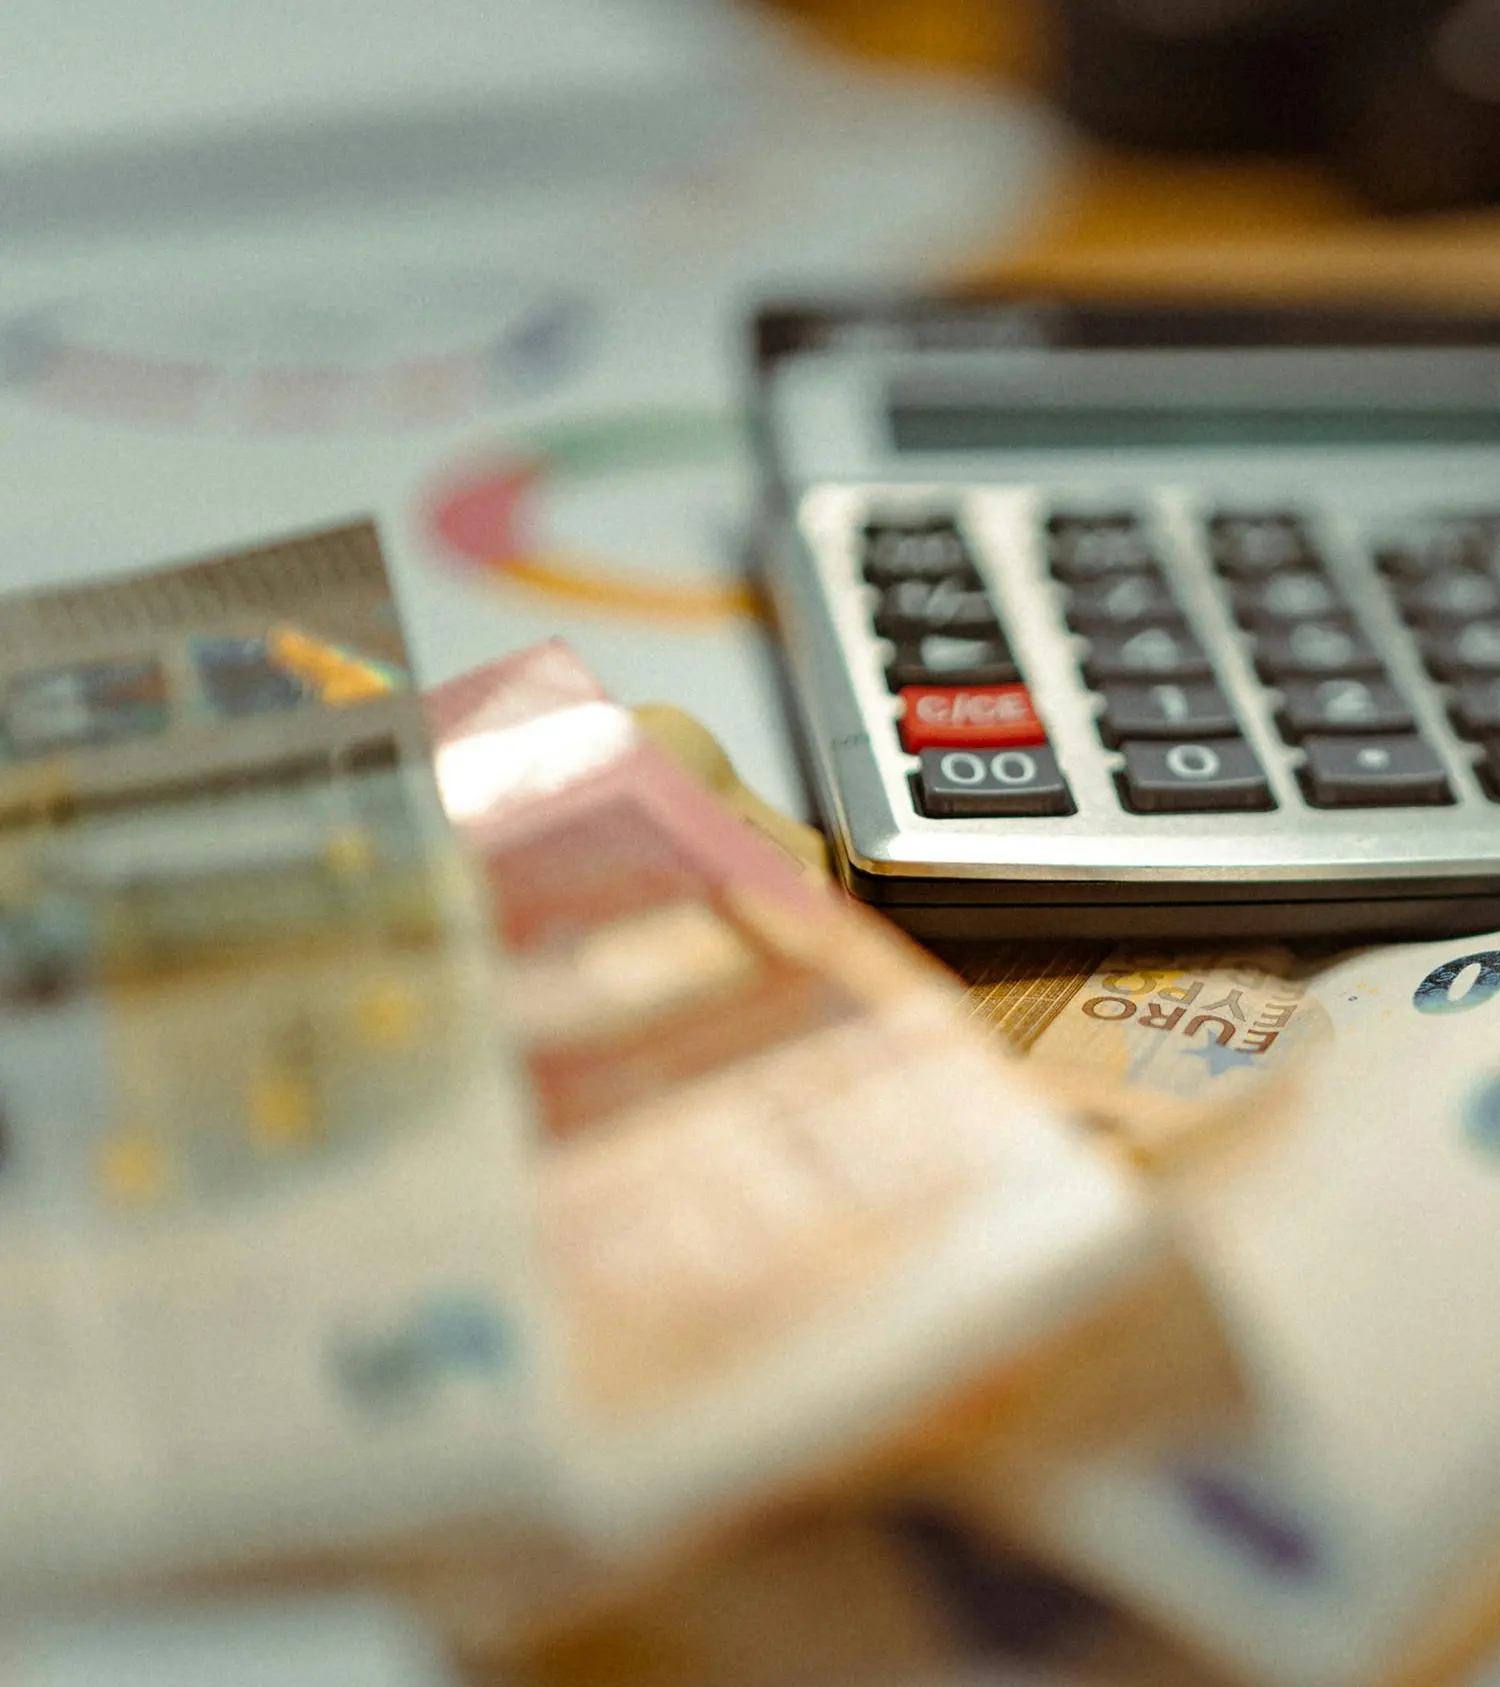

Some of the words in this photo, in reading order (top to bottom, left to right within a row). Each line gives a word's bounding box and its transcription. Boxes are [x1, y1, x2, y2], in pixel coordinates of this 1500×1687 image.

[915, 690, 1028, 727] C/CE
[1152, 683, 1189, 725] 1
[940, 751, 1038, 786] 00
[1165, 744, 1220, 779] 0
[1081, 995, 1280, 1055] EURO
